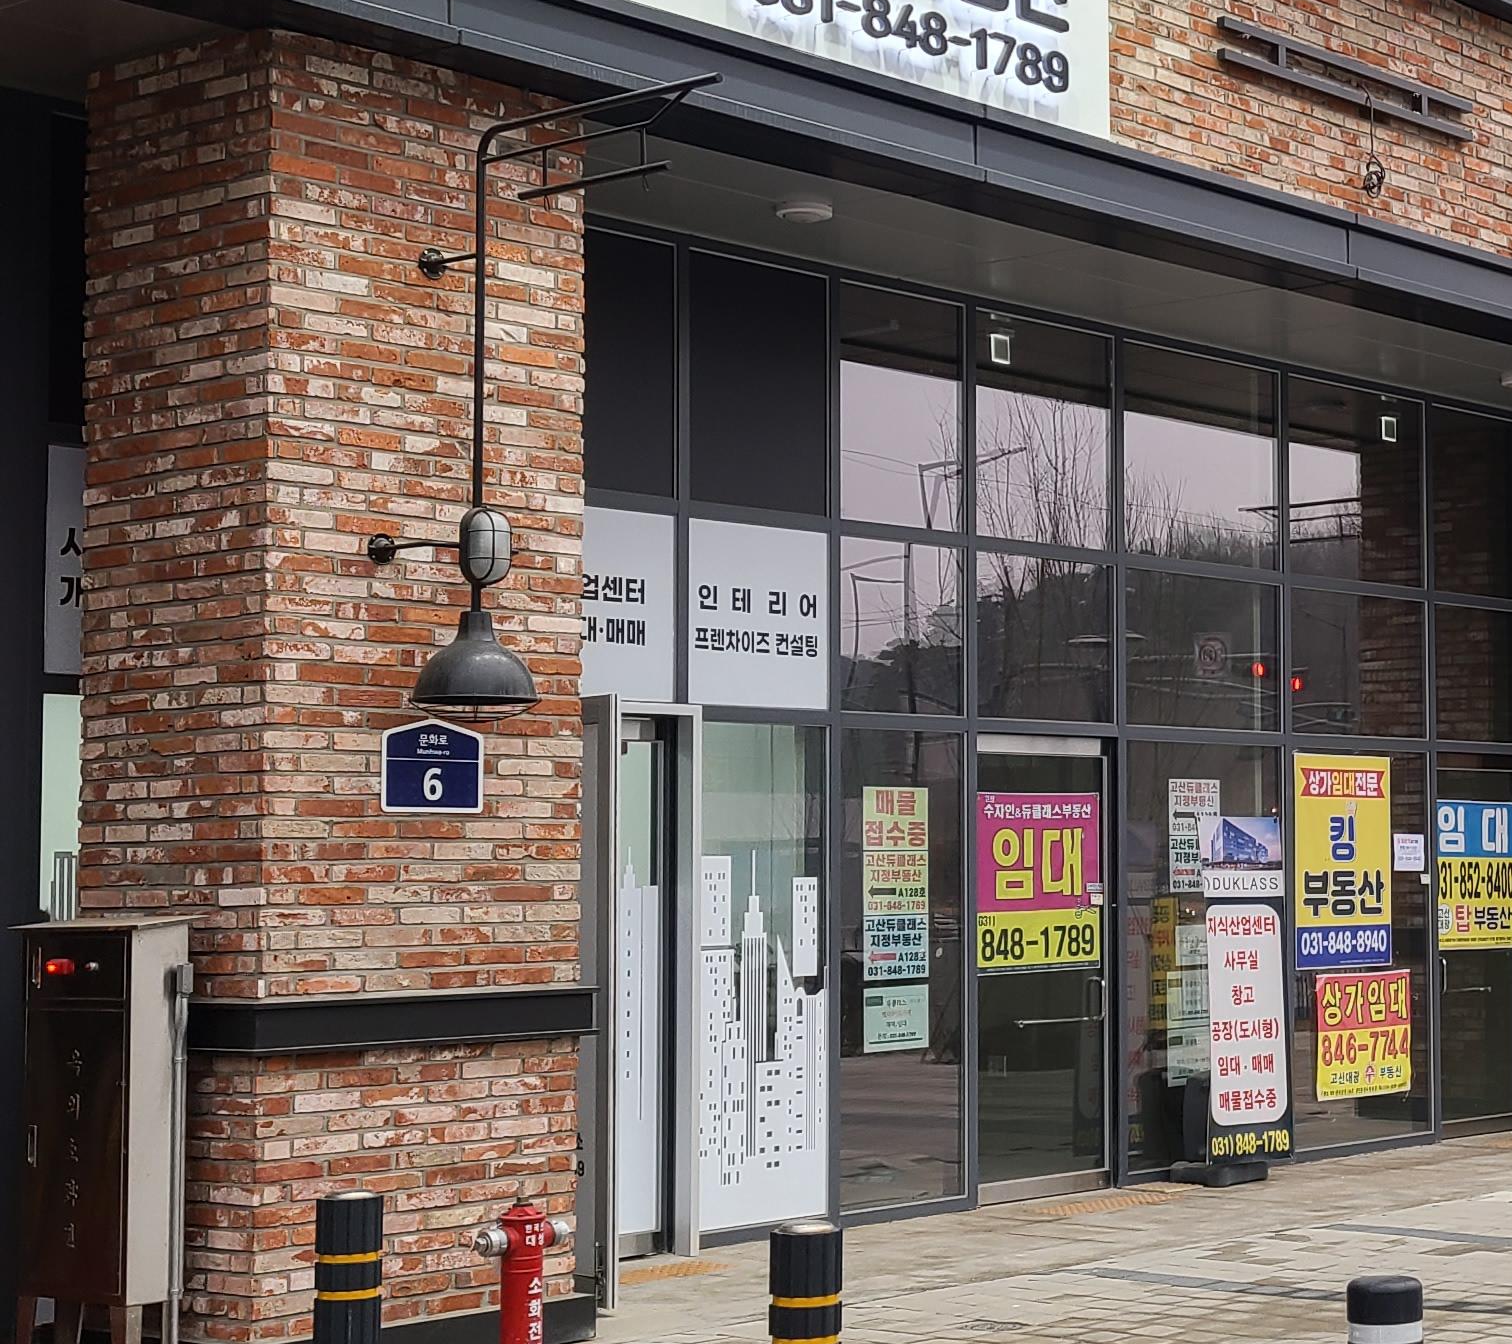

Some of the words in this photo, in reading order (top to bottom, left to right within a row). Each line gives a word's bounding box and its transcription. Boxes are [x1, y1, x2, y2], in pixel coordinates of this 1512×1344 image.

[695, 628, 770, 654] 프렌차이즈
[775, 633, 818, 657] 컨설팅
[419, 734, 448, 747] 문화로
[423, 767, 443, 801] 6
[1308, 770, 1378, 796] 상가임대전문
[875, 790, 917, 816] 매물
[865, 821, 926, 847] 접수중
[1330, 815, 1355, 861] 킹
[871, 870, 922, 883] 지정부동산
[992, 827, 1083, 900] 임대
[1303, 869, 1385, 917] 부동산
[865, 918, 927, 932] 고산듀클래스
[1208, 916, 1276, 936] 지식산업센터
[1455, 905, 1471, 932] 탑
[1474, 907, 1512, 930] 부동산
[871, 933, 922, 947] 지정부동산
[982, 923, 1094, 962] 848-1789
[1301, 929, 1387, 956] 031-848-8940
[1224, 950, 1258, 971] 사무실
[1232, 985, 1255, 1006] 창고
[1321, 976, 1408, 1026] 상가임대
[1212, 1017, 1279, 1042] 공장(도시형)
[1321, 1027, 1409, 1067] 846-7744
[1218, 1056, 1241, 1077] 임대
[1252, 1053, 1274, 1074] 매매
[1219, 1088, 1277, 1112] 매물접수중
[1211, 1135, 1234, 1156] 031)
[1236, 1129, 1290, 1155] 848-1789
[528, 1277, 542, 1341] 소화전
